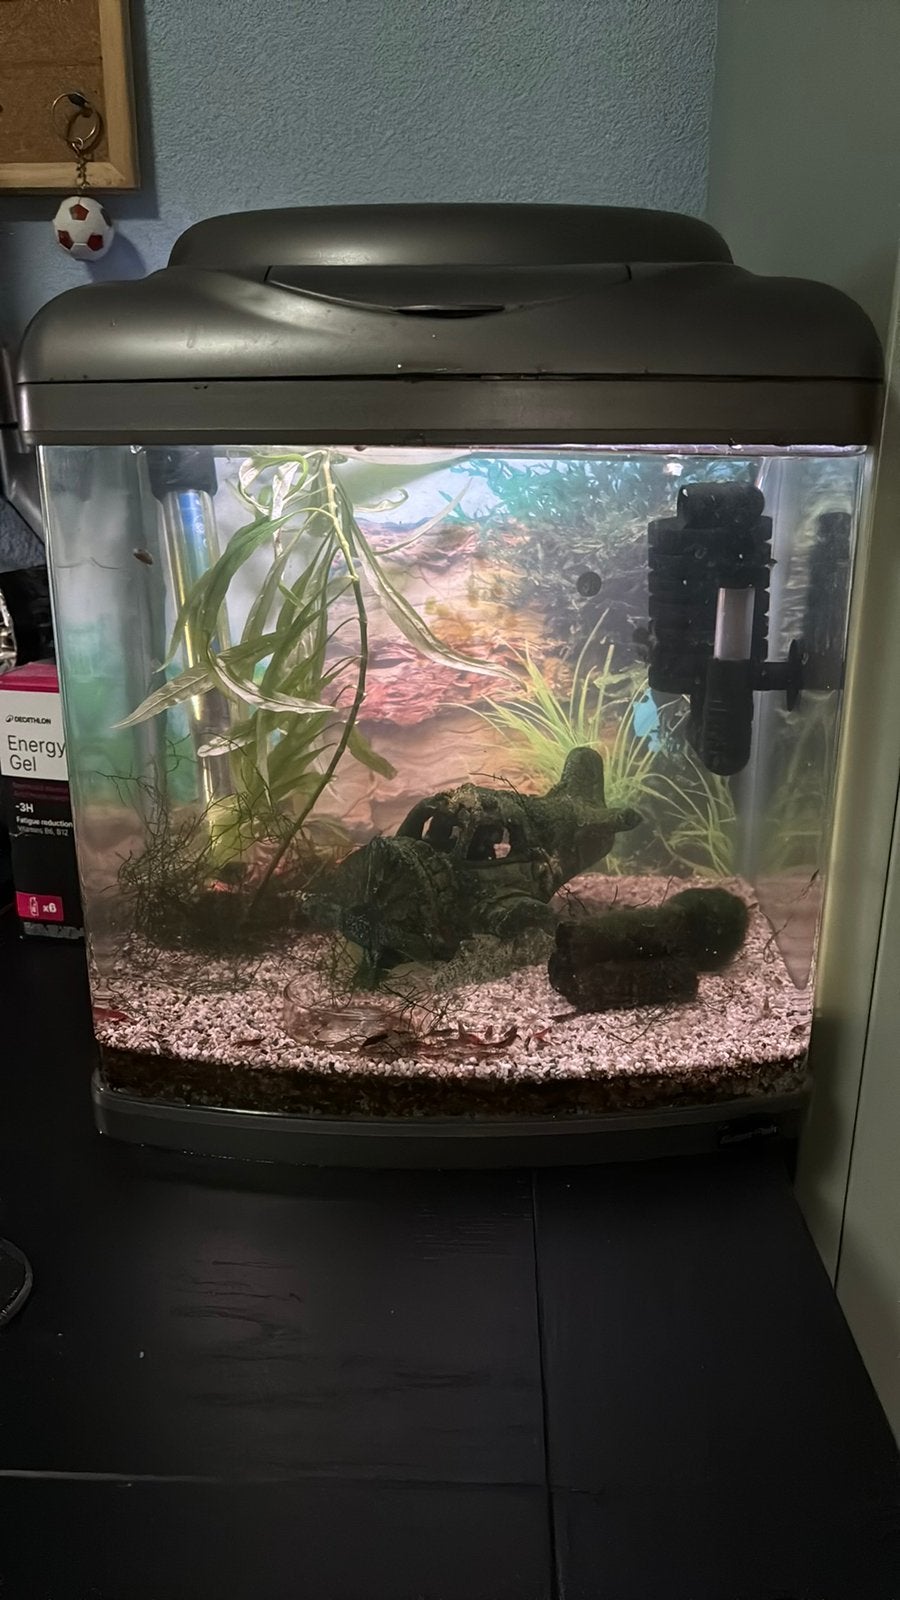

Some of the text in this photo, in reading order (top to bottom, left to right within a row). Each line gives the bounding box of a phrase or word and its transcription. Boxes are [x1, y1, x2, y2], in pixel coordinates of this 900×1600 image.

[14, 716, 52, 724] DECATHLON
[8, 734, 66, 758] Energy
[10, 754, 36, 771] Gel
[15, 802, 34, 813] -3H
[16, 816, 73, 828] Fatigue reduction
[56, 828, 69, 836] B12
[42, 902, 57, 913] x6
